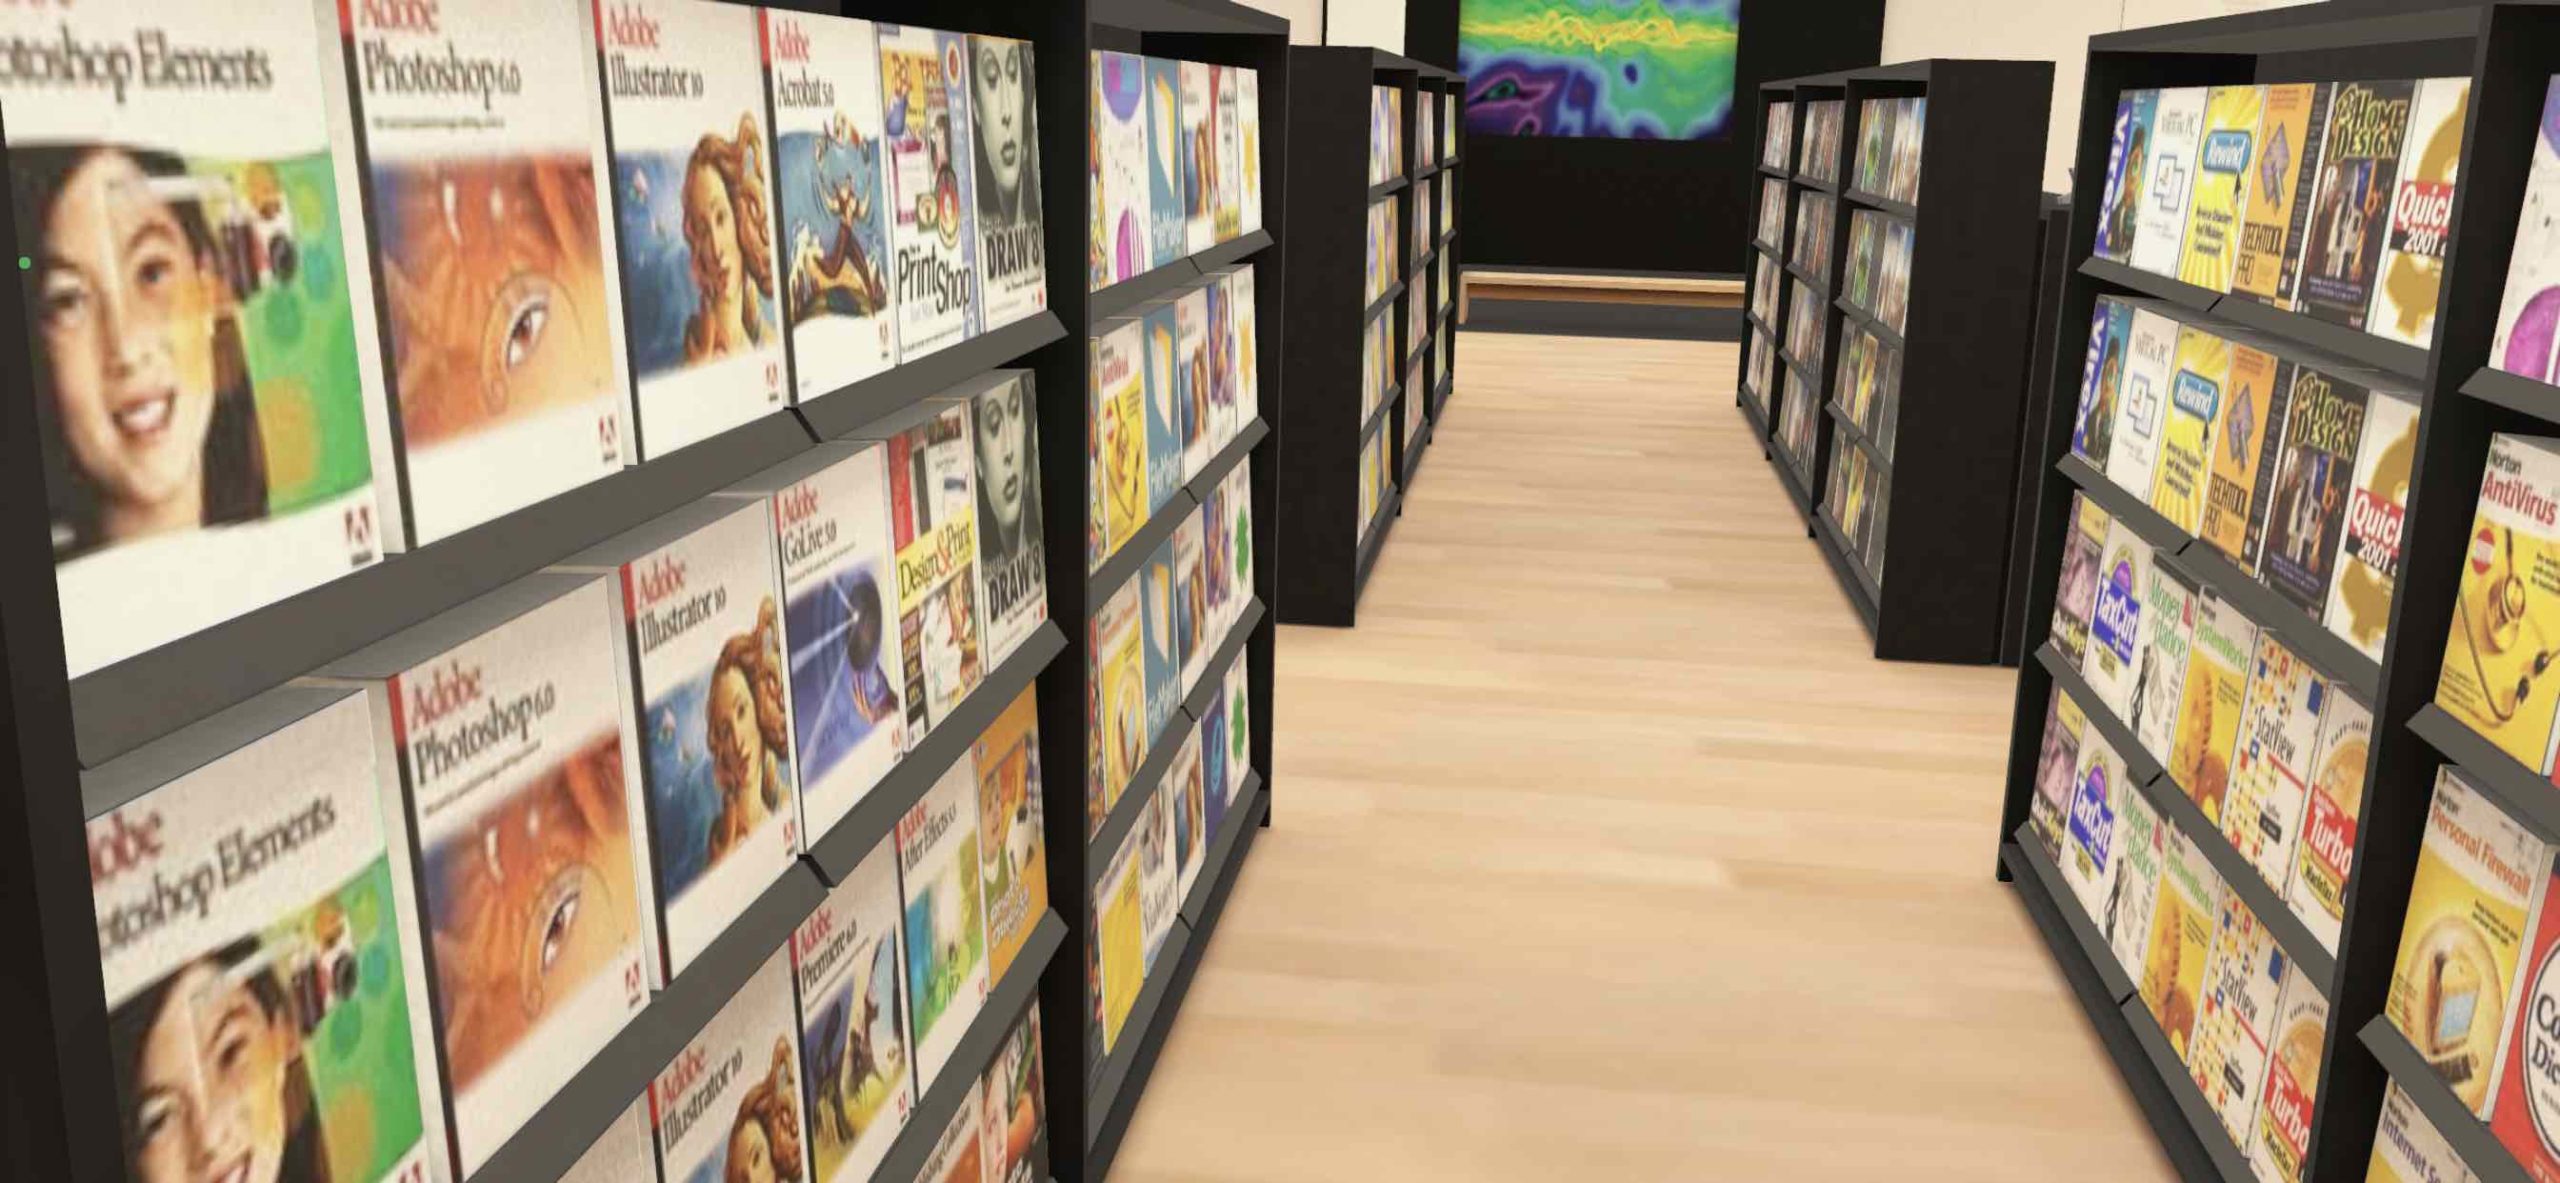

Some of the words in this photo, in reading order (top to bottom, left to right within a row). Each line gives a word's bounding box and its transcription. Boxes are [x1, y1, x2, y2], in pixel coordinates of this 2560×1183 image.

[608, 6, 660, 49] Adobe
[774, 18, 810, 62] Adobe
[136, 28, 272, 90] Elements
[363, 38, 493, 110] Photoshop
[610, 54, 688, 100] Illustrator
[777, 69, 820, 108] Acrobat
[2206, 136, 2249, 170] Rewind
[986, 228, 1028, 282] DRAW
[1031, 223, 1041, 267] 8
[2404, 226, 2441, 255] 2001
[899, 244, 937, 305] Print
[936, 260, 971, 317] Shop
[2177, 378, 2217, 418] Rewind
[2490, 448, 2522, 475] Norton
[783, 483, 818, 528] Adobe
[2482, 470, 2558, 526] AntiVirus
[783, 525, 823, 568] GoLive
[900, 551, 939, 601] Design
[946, 521, 972, 556] Print
[2358, 536, 2391, 571] 2001
[640, 555, 686, 609] Adobe
[989, 553, 1029, 623] DRAW
[1032, 544, 1041, 584] 8
[641, 590, 712, 655] Illustrator
[2099, 577, 2140, 648] TaxCut
[412, 656, 482, 732] Adobe
[414, 693, 533, 788] Photoshop
[216, 795, 337, 888] Elements
[2072, 774, 2114, 853] TaxCut
[2309, 806, 2352, 877] Turbo
[2431, 803, 2482, 861] Personal
[2482, 841, 2533, 899] Firewall
[799, 906, 832, 958] Adobe
[801, 930, 847, 996] Premiere
[661, 1044, 709, 1104] Adobe
[663, 1061, 732, 1151] Illustrator
[2271, 1086, 2311, 1154] Turbo
[2381, 1111, 2428, 1180] Internet
